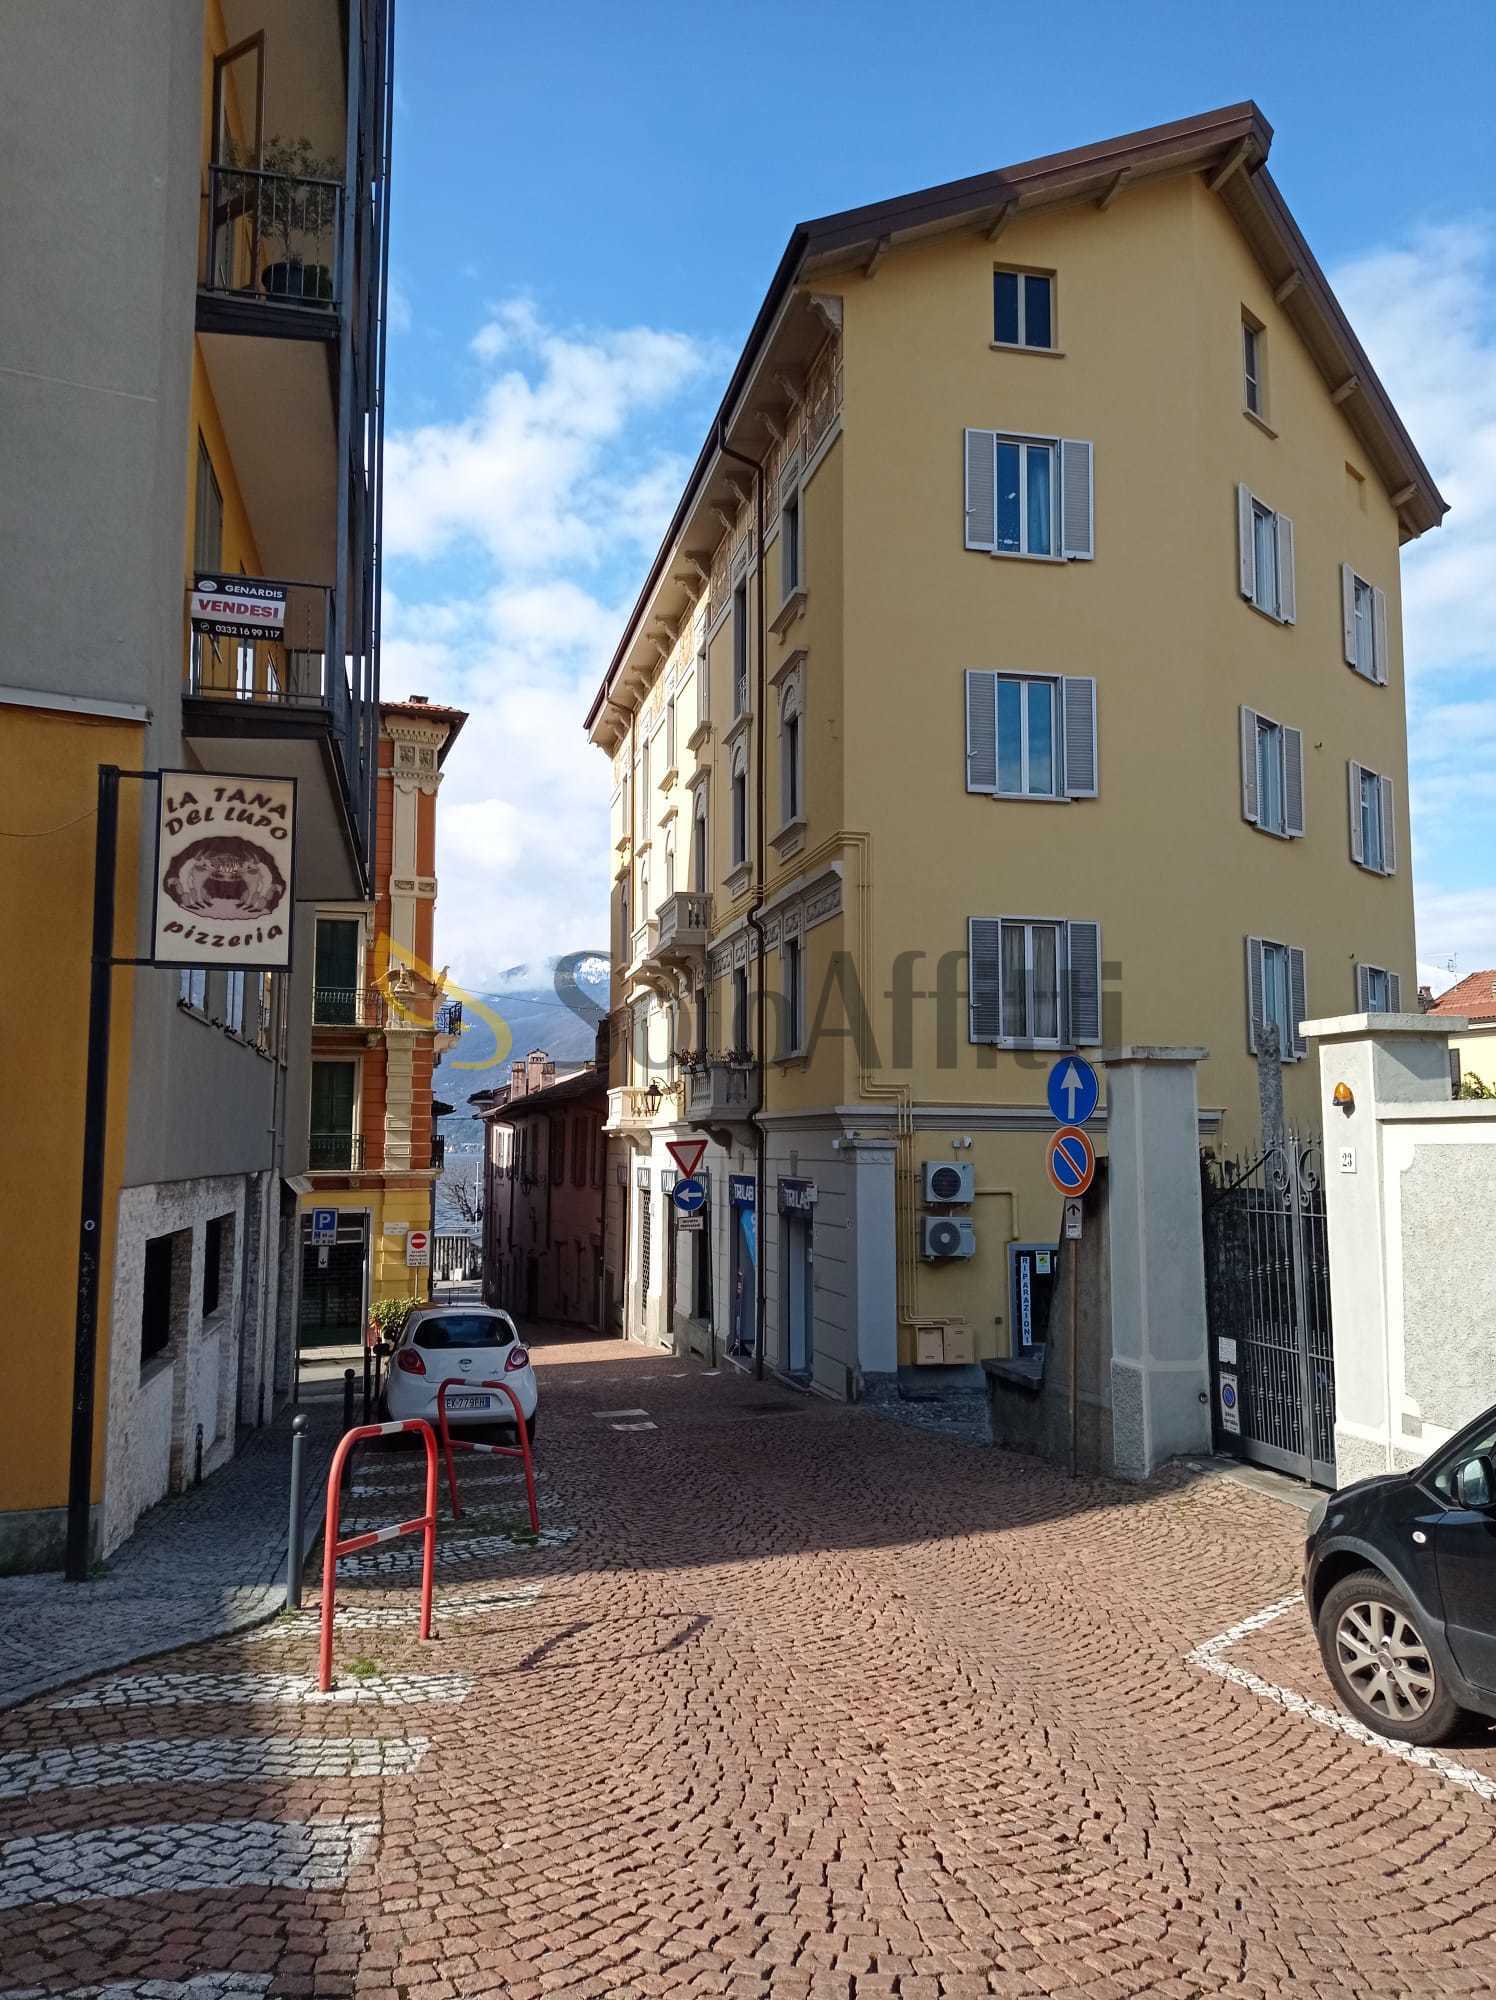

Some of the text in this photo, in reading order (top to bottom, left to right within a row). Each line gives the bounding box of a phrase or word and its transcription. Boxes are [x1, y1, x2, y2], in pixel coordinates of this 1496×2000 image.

[225, 585, 283, 598] GENARDIS
[198, 599, 279, 618] VENDESI
[215, 625, 280, 638] 0332 16 99 117
[167, 787, 287, 820] LA TANA
[163, 920, 283, 948] pizzeria
[320, 1213, 331, 1228] P
